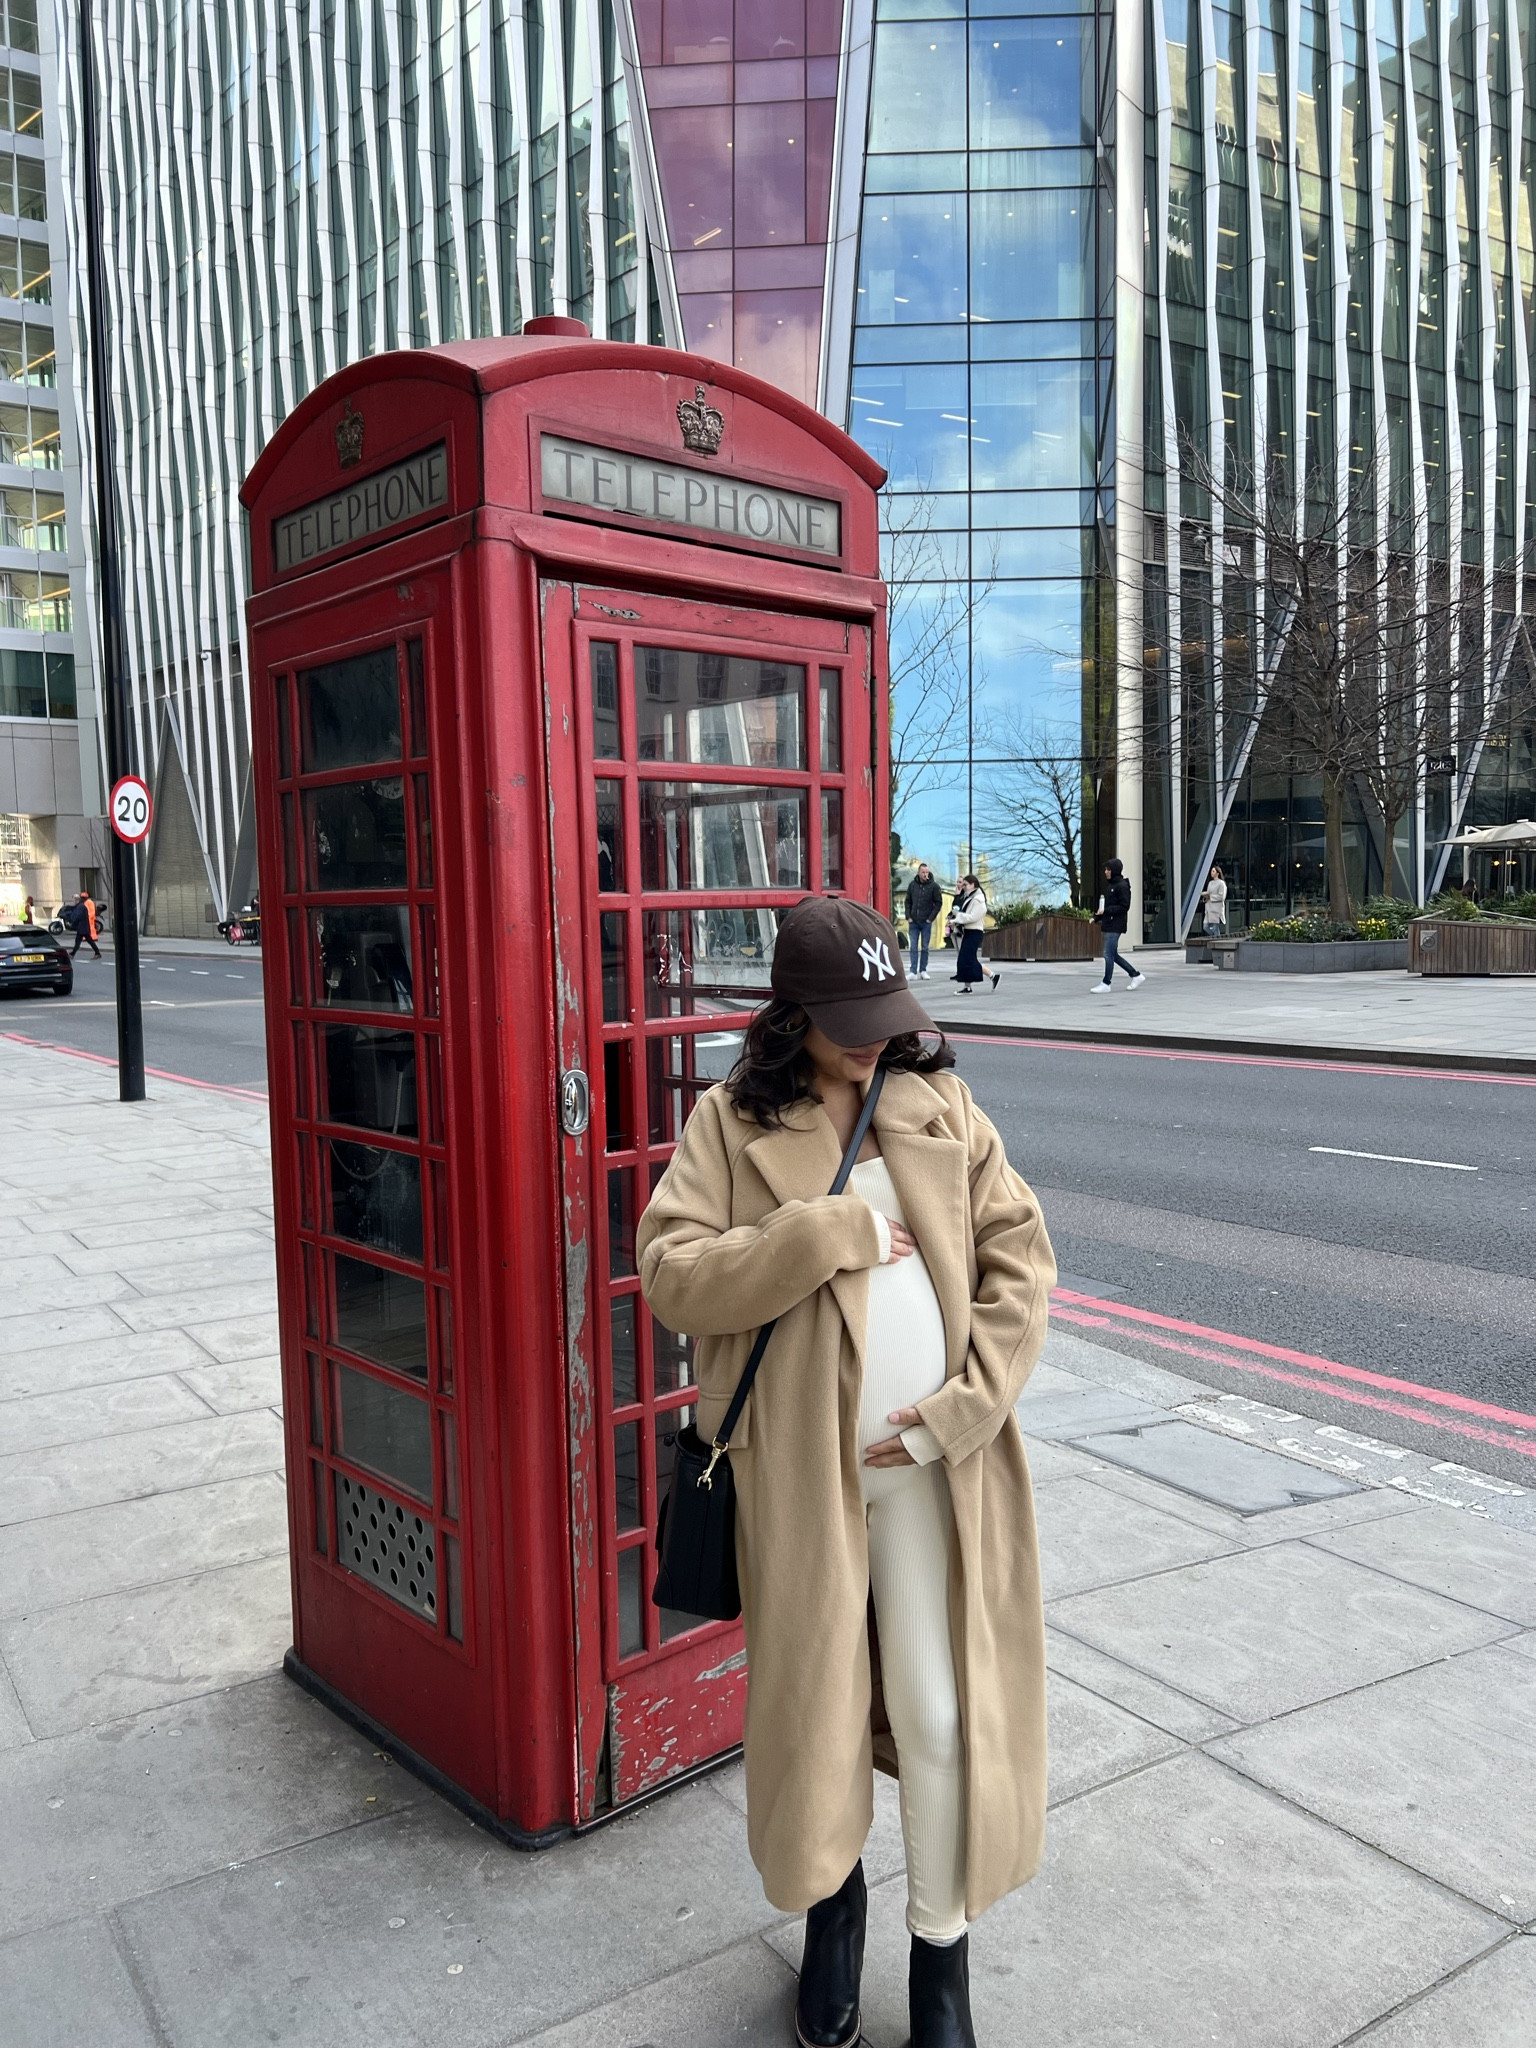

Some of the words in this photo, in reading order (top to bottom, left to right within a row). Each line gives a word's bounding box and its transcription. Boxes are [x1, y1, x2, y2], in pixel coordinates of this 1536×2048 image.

[281, 453, 443, 564] TELEPHONE
[553, 447, 826, 549] TELEPHONE
[117, 795, 147, 824] 20
[857, 936, 897, 982] NY
